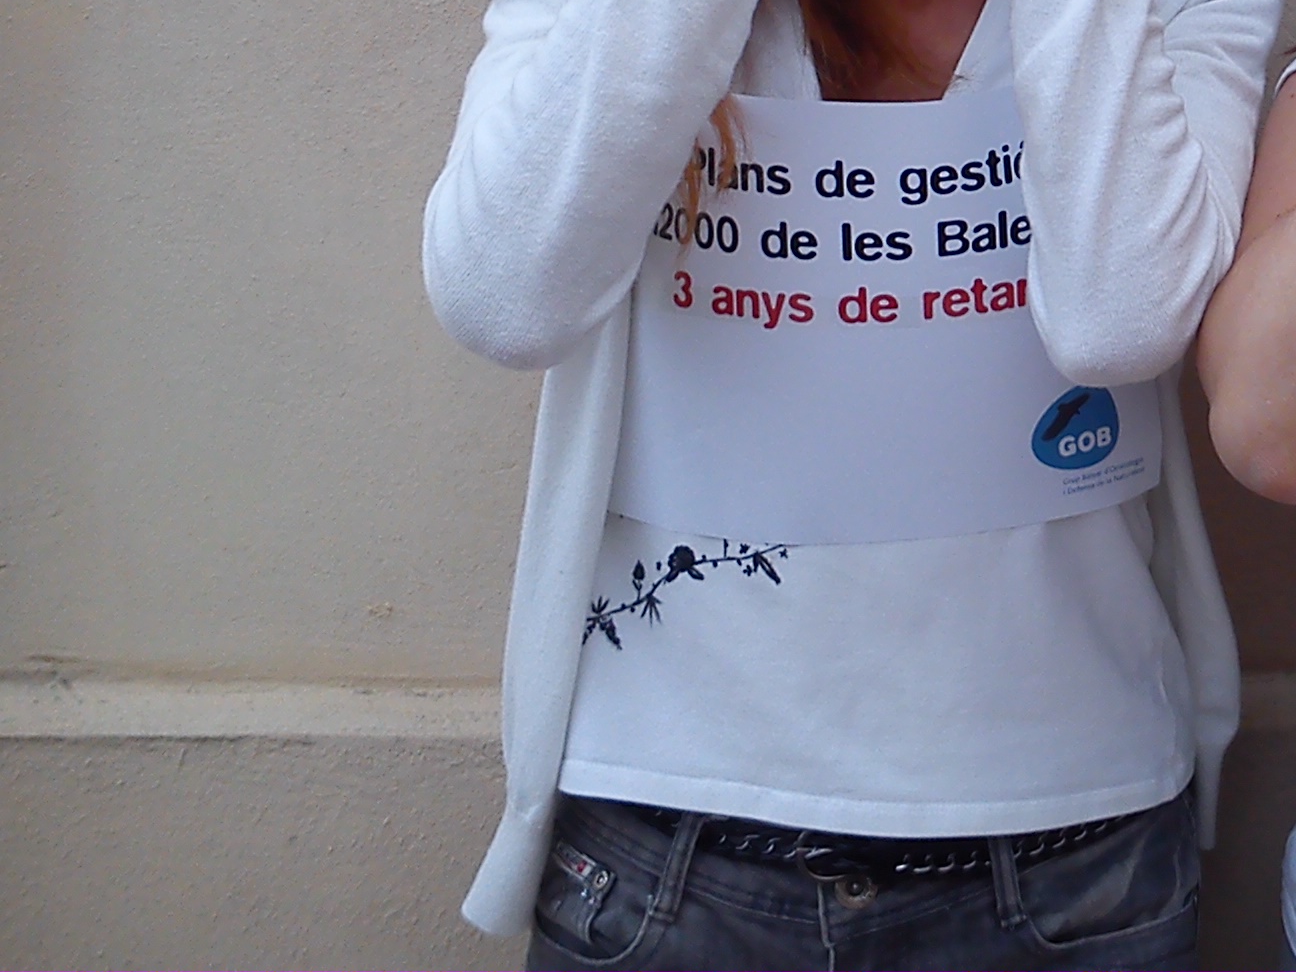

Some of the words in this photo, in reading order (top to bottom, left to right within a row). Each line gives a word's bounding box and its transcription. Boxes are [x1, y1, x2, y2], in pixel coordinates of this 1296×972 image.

[814, 159, 875, 199] de
[653, 202, 739, 253] 2000
[760, 221, 818, 261] de
[841, 222, 913, 262] les
[672, 270, 693, 309] 3
[711, 285, 815, 330] anys
[837, 286, 898, 325] de
[1058, 426, 1112, 457] GOB
